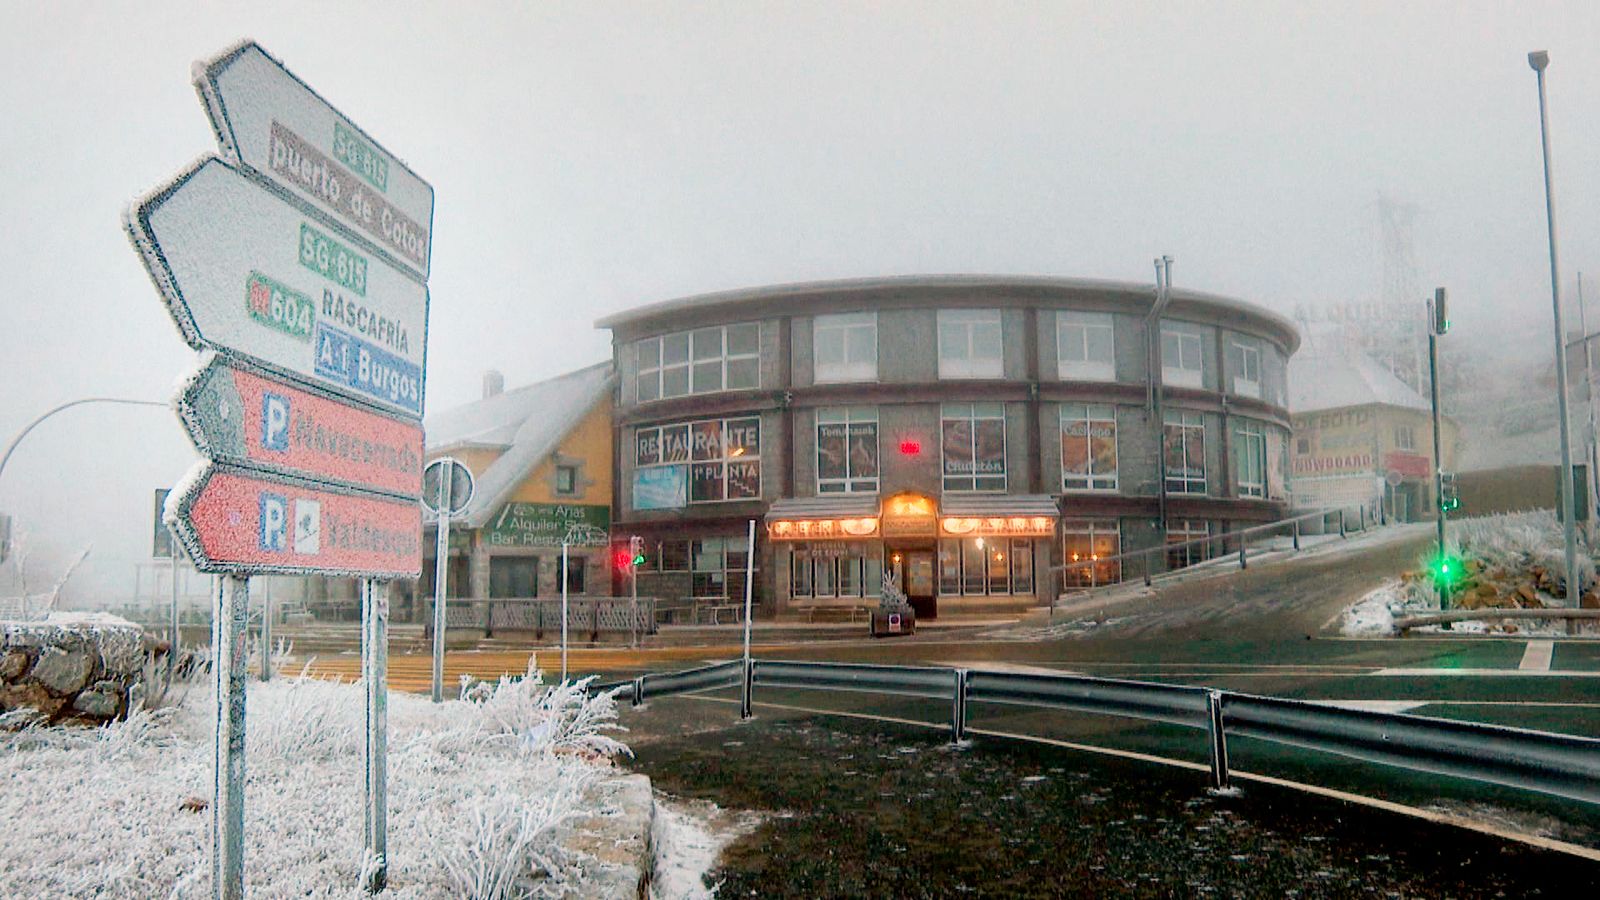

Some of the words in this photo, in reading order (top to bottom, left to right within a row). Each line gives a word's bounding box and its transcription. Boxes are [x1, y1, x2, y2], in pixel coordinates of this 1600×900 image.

[351, 189, 372, 223] de
[382, 208, 425, 258] Cotos
[322, 288, 409, 354] RASCAFRÍA
[358, 348, 418, 400] Burgos
[269, 397, 288, 444] P
[640, 427, 757, 456] RESTAURANTE
[706, 465, 757, 480] PLANTA
[265, 502, 284, 547] P
[491, 532, 515, 545] Bar
[510, 518, 560, 532] Alquiler
